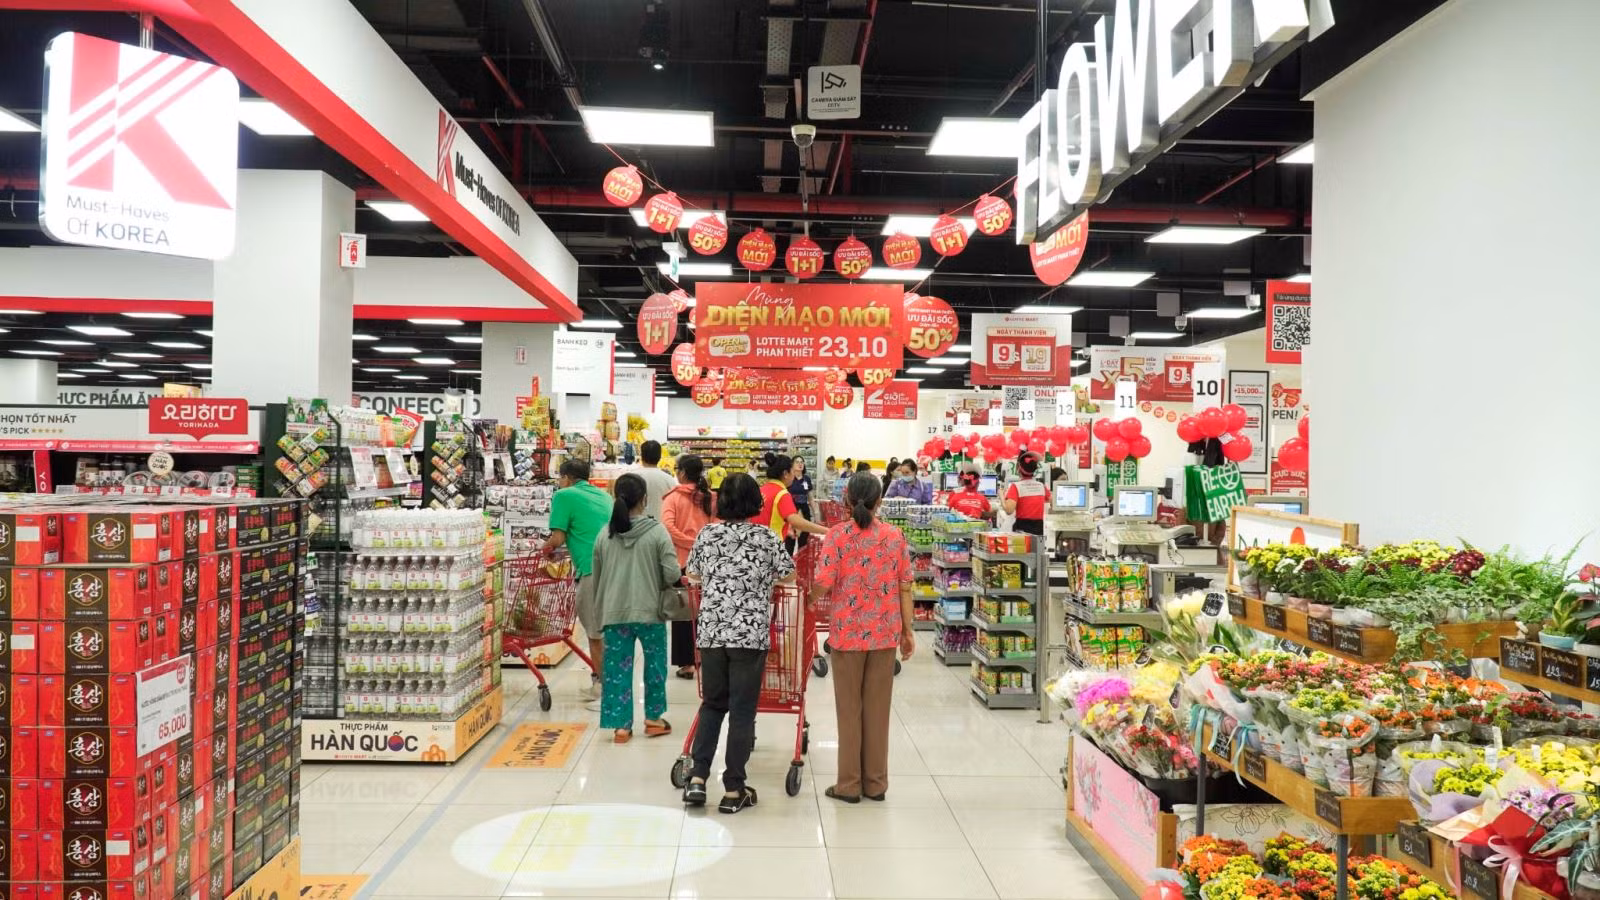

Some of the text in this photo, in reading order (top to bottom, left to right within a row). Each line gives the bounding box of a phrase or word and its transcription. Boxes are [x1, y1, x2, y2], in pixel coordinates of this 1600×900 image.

[649, 207, 676, 231] 1+1
[983, 213, 1011, 234] 50%
[67, 217, 170, 247] Of KOREA
[1055, 220, 1081, 249] MỚI
[692, 232, 721, 251] 50%
[936, 232, 965, 253] 1+1
[742, 248, 769, 263] MỚI
[889, 249, 916, 264] MỚI
[791, 257, 817, 274] 1+1
[840, 258, 870, 275] 50%
[706, 301, 891, 332] DIỆN MẠO MỚI
[907, 313, 954, 325] ƯU ĐÃI SỐC
[644, 320, 670, 347] 1+1
[756, 336, 815, 346] LOTTE MART
[909, 327, 953, 351] 50%
[756, 346, 815, 357] PHAN THIẾT
[818, 336, 888, 359] 23.10
[998, 345, 1010, 362] 9
[677, 364, 700, 381] 50%
[863, 368, 893, 385] 50%
[1173, 369, 1183, 382] 9
[1196, 380, 1219, 396] 10
[696, 393, 719, 404] 50%
[783, 394, 817, 406] 23.10
[829, 393, 848, 406] 1+1
[1119, 395, 1134, 409] 11
[160, 403, 238, 421] 요리하다
[1020, 410, 1034, 421] 13
[1059, 404, 1073, 416] 12
[1272, 409, 1299, 421] PEN!
[0, 413, 77, 425] HỌN TỐT NHẤT
[10, 427, 30, 435] PICK
[928, 426, 937, 434] 17
[1200, 469, 1220, 493] RE:
[1206, 489, 1246, 522] EARTH
[90, 522, 124, 543] 홍삼
[67, 577, 102, 599] 홍삼
[67, 631, 102, 652] 홍삼
[66, 684, 102, 705] 홍삼
[158, 713, 187, 740] 65,000
[340, 721, 389, 733] THỰC PHẨM
[68, 736, 103, 757] 홍삼
[310, 729, 419, 752] HÀN QUỐC
[65, 788, 101, 808] 홍삼
[65, 840, 100, 860] 홍삼
